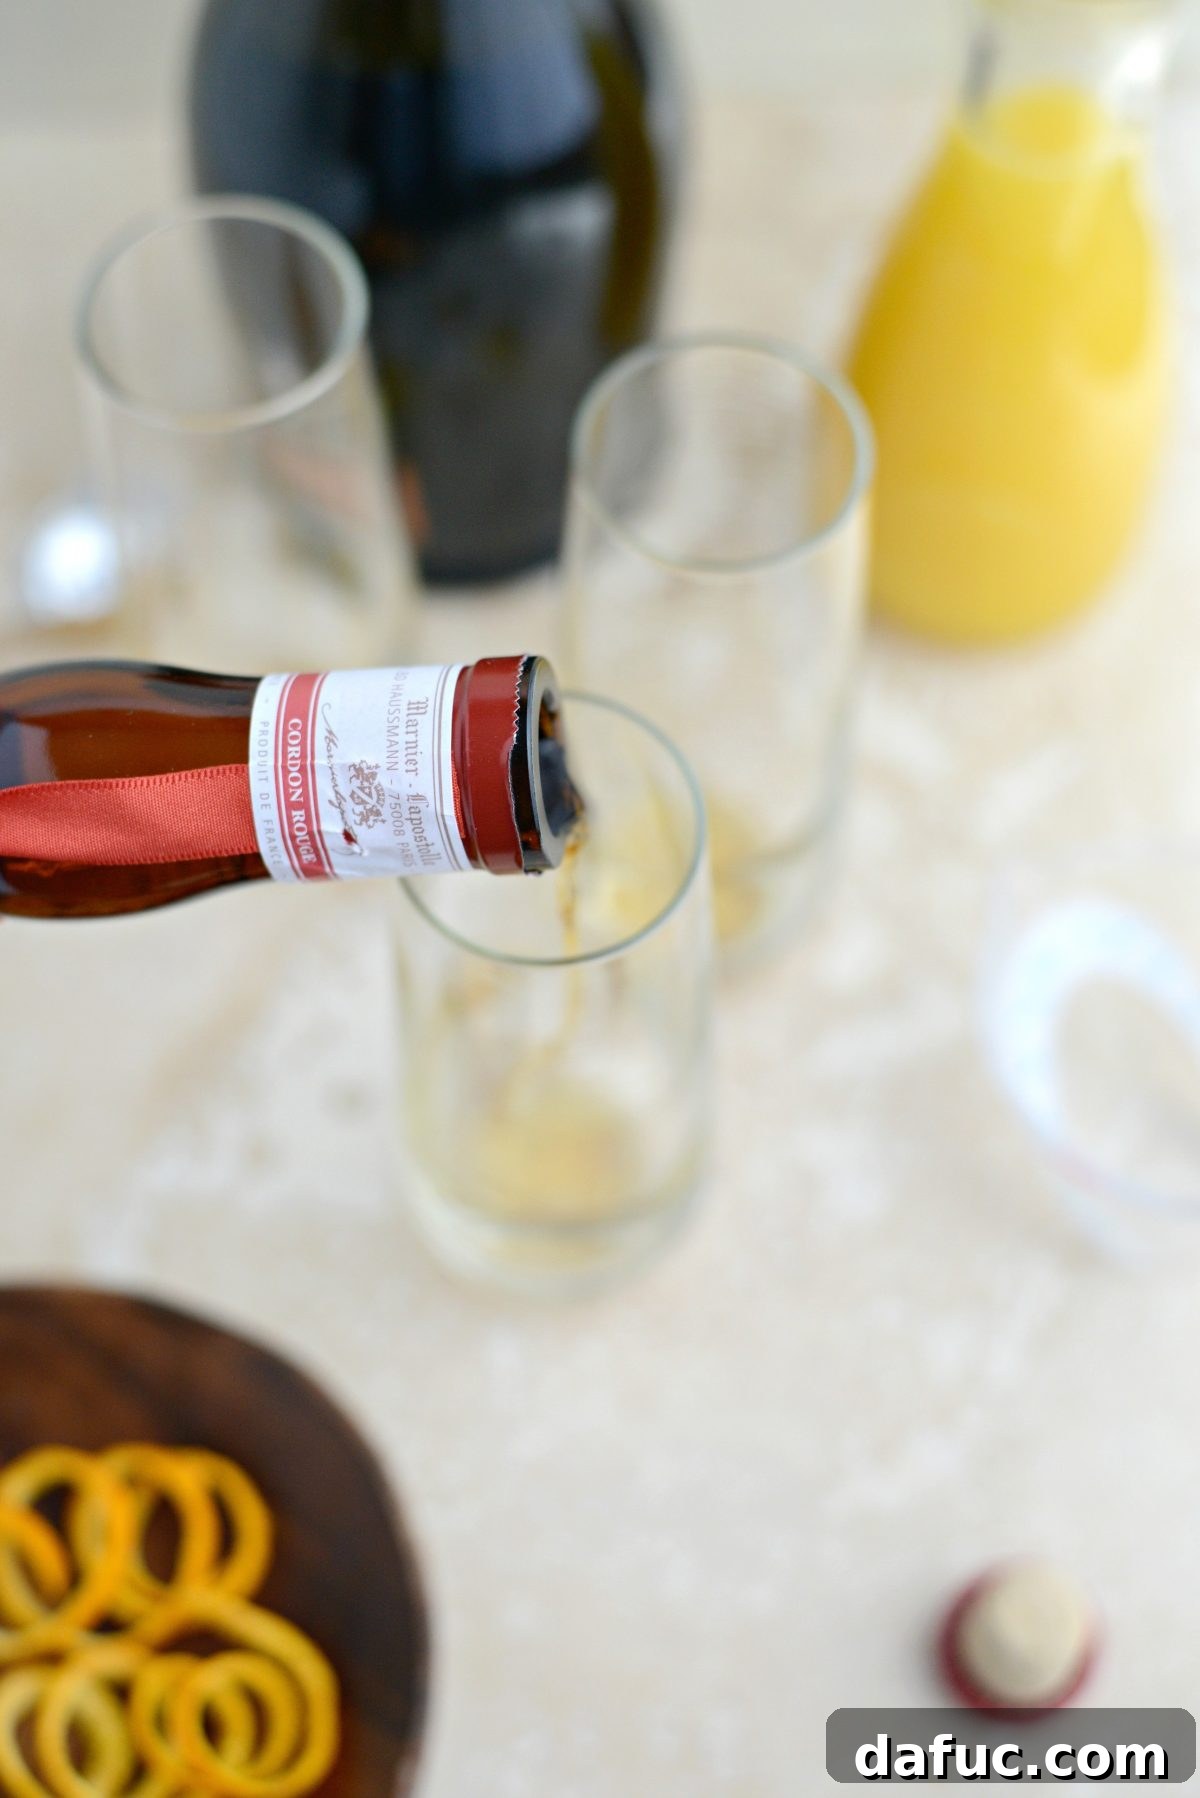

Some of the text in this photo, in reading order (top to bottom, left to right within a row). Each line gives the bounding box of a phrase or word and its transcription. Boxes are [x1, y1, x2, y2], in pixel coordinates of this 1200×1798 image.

[257, 720, 270, 784] PRODUIT
[385, 683, 405, 771] HAUSSMANN
[404, 696, 430, 777] Marnier
[259, 792, 270, 811] DE
[286, 717, 317, 864] CORDON ROUGE
[387, 791, 406, 837] 75008
[263, 819, 284, 865] FRANCE
[406, 793, 442, 867] Lapostolle
